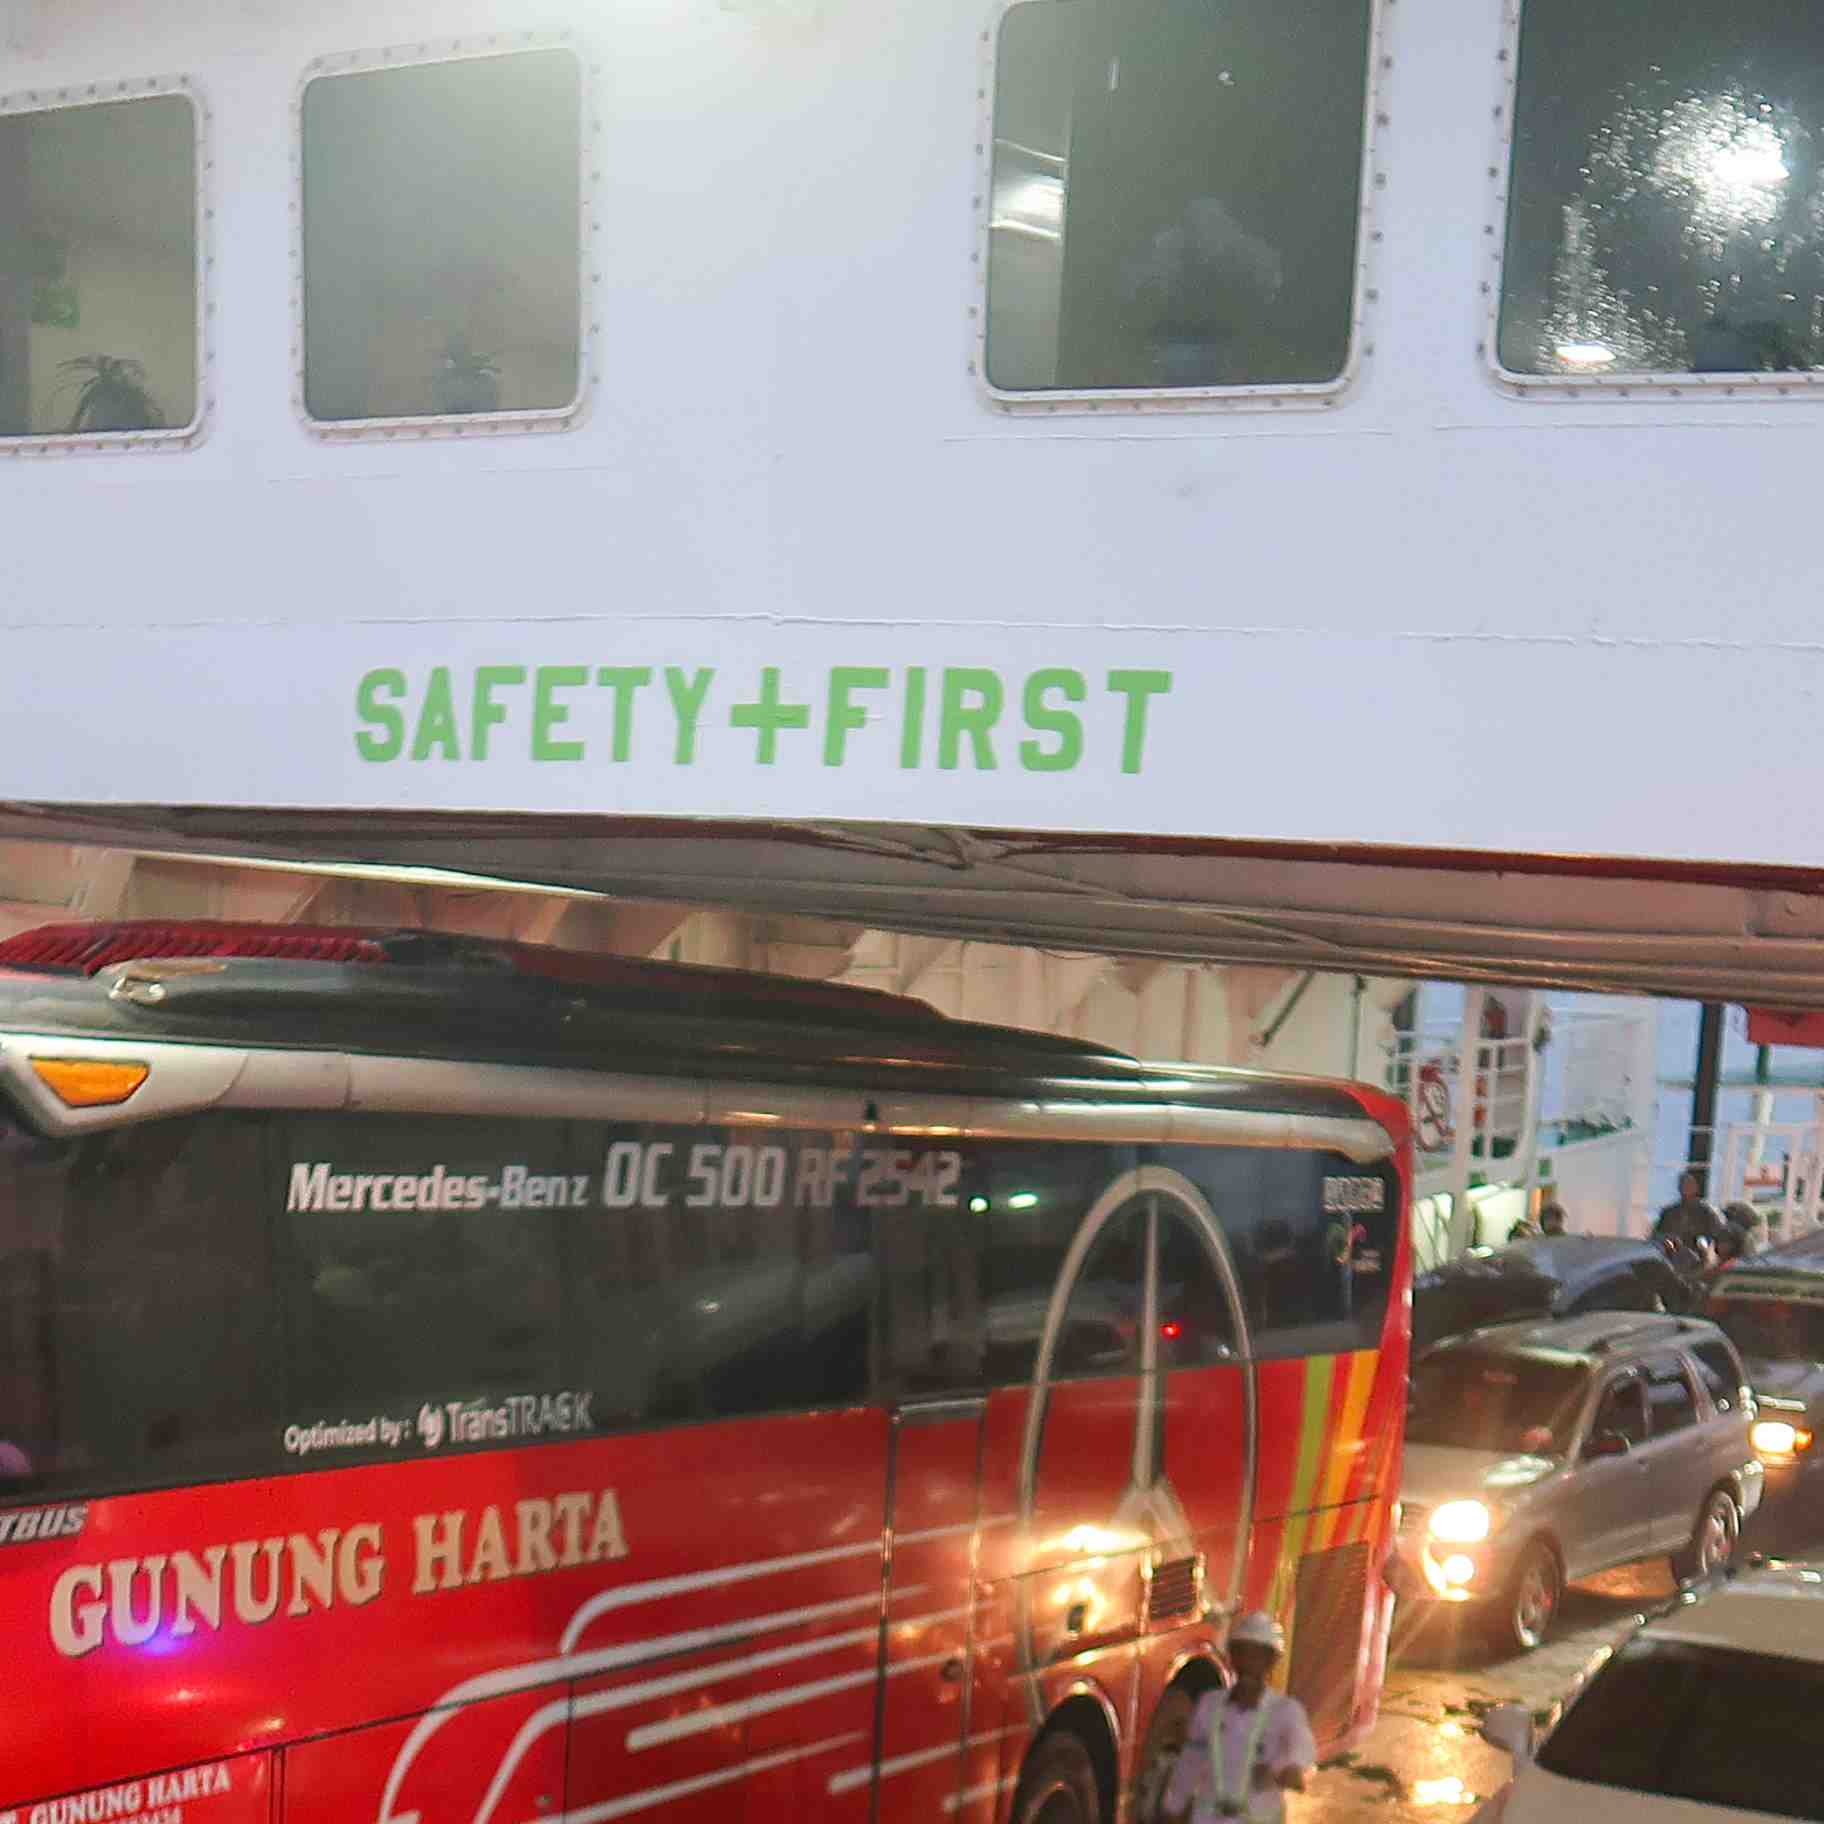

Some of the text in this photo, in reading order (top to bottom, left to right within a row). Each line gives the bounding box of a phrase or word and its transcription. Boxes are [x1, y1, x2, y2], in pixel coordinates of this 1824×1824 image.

[285, 1141, 962, 1213] Mercedes-Benz OC 500 RF 2542
[283, 1417, 376, 1456] Optimized
[49, 1488, 628, 1658] GUNUNG HARTA
[147, 1763, 231, 1808] HARTA
